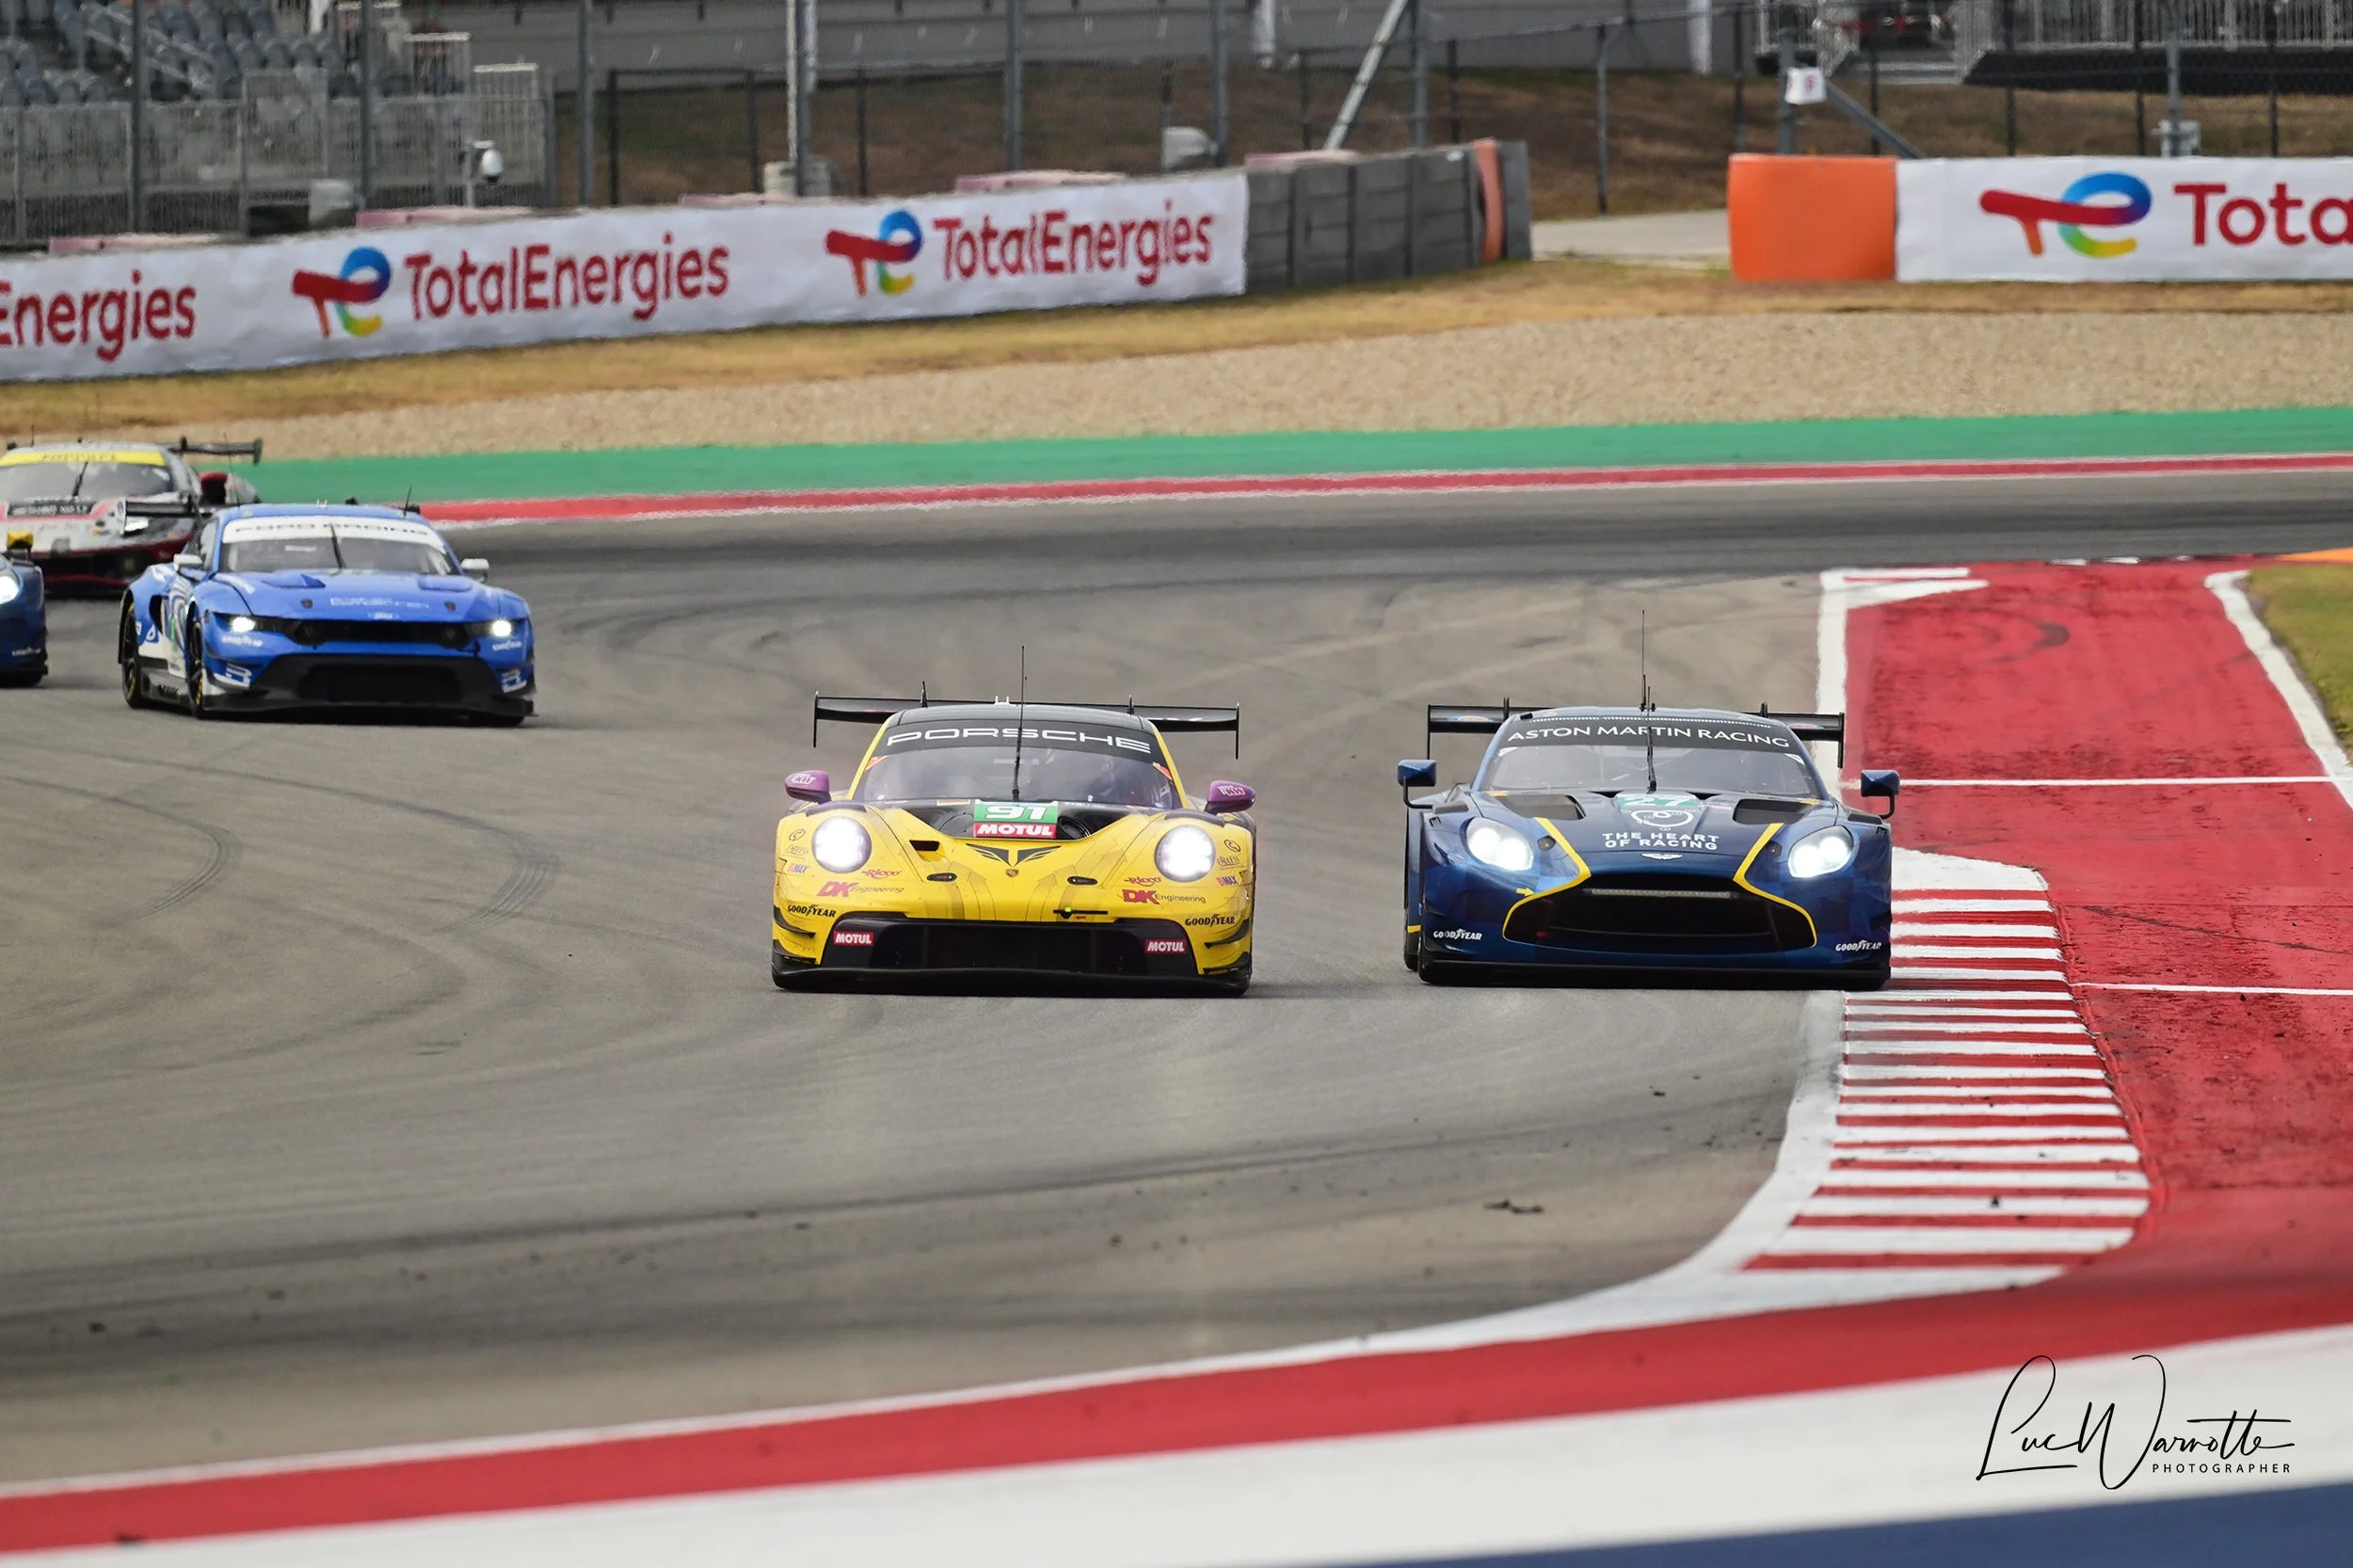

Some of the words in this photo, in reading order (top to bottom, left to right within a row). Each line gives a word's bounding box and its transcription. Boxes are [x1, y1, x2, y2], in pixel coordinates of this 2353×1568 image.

[2173, 183, 2353, 247] Tota
[933, 199, 1215, 286] TotalEnergies
[405, 233, 729, 322] TotalEnergies
[887, 728, 1151, 754] PORSCHE
[1508, 727, 1592, 742] ASTON
[1597, 726, 1692, 738] MARTIN
[1698, 728, 1790, 748] RACING
[984, 805, 1048, 821] 91
[977, 824, 1054, 837] MOTUL
[1602, 832, 1641, 840] THE
[1650, 832, 1719, 842] HEART
[1605, 839, 1630, 848] OF
[1640, 839, 1718, 850] RACING
[817, 880, 858, 897] DK
[849, 885, 904, 893] Engineering
[1121, 888, 1160, 904] DK
[1154, 893, 1206, 904] Engineering
[835, 933, 873, 944] MOTUL
[1146, 941, 1185, 952] MOTUL
